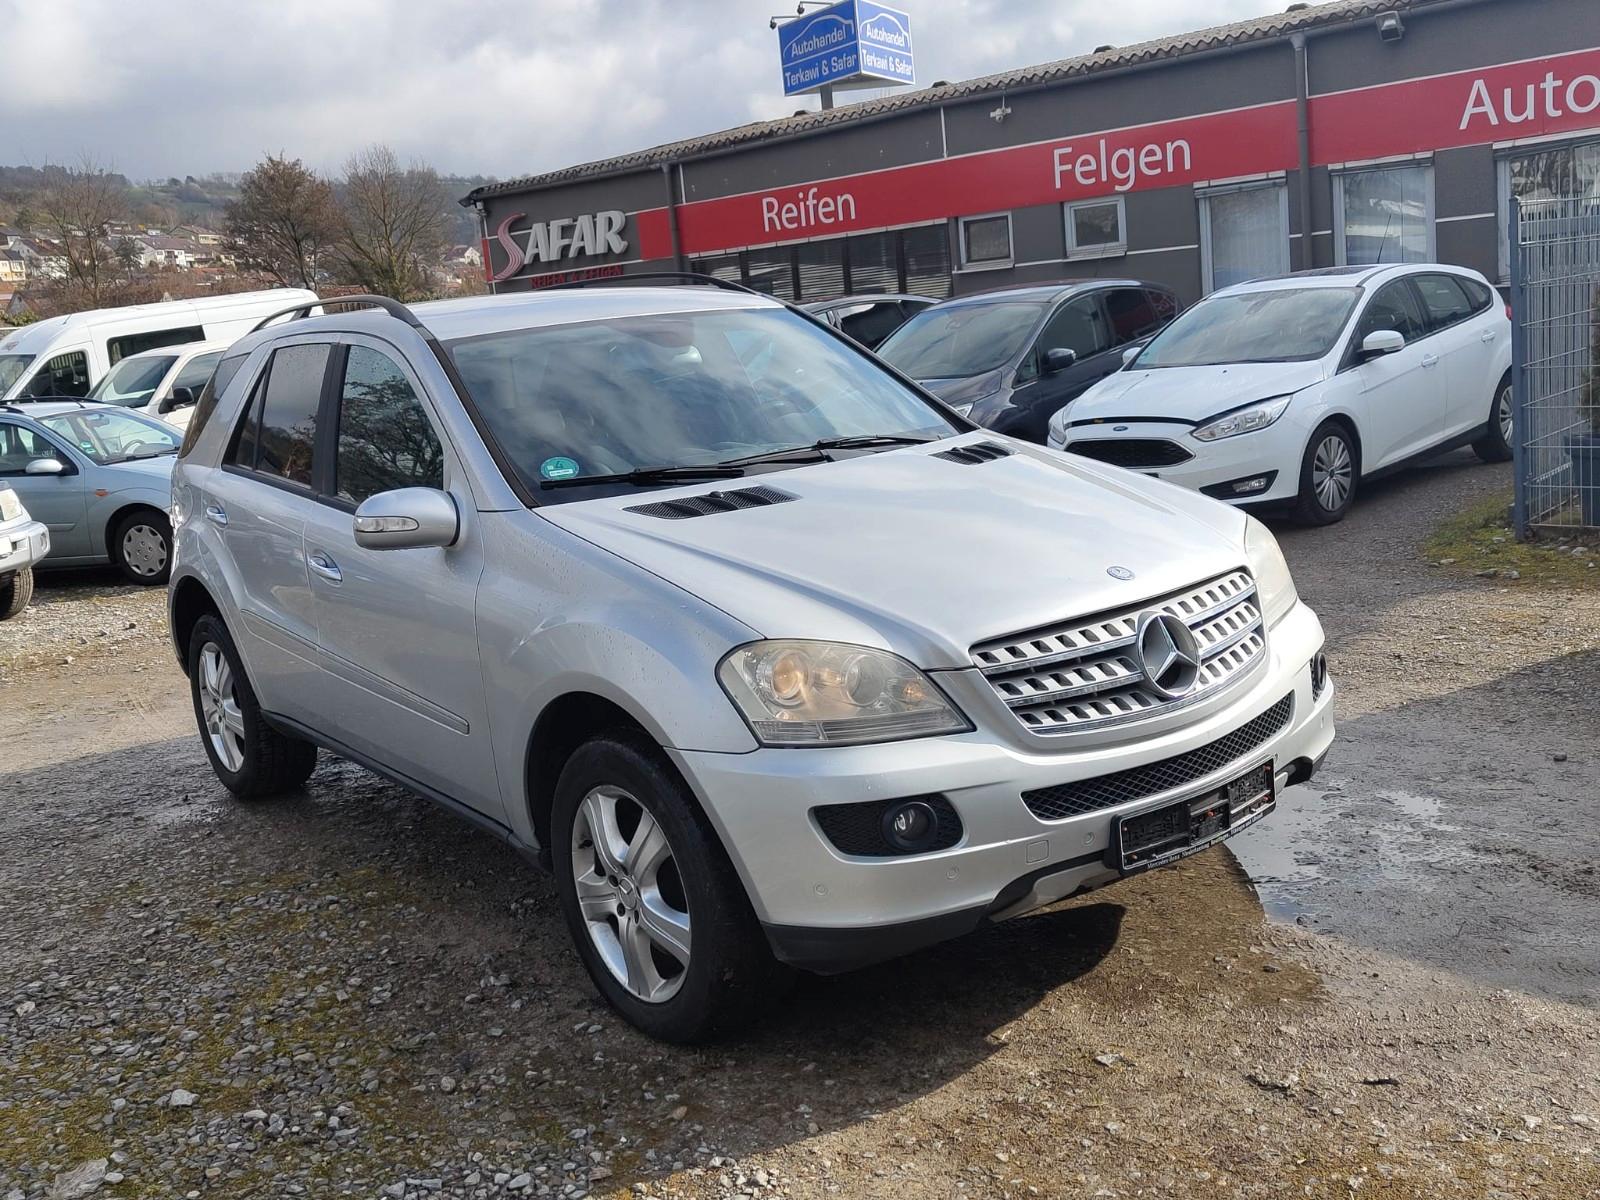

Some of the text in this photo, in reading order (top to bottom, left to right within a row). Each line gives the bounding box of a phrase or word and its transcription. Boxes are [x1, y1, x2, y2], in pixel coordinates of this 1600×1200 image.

[791, 25, 846, 58] Autohandel
[866, 23, 905, 47] Autohandel
[785, 54, 857, 87] Terkawi & Safar
[862, 49, 912, 76] Terkawi & Safar
[1458, 71, 1600, 131] Auto
[1052, 138, 1192, 192] Felgen
[762, 187, 856, 232] Reifen
[494, 211, 629, 281] SAFAR
